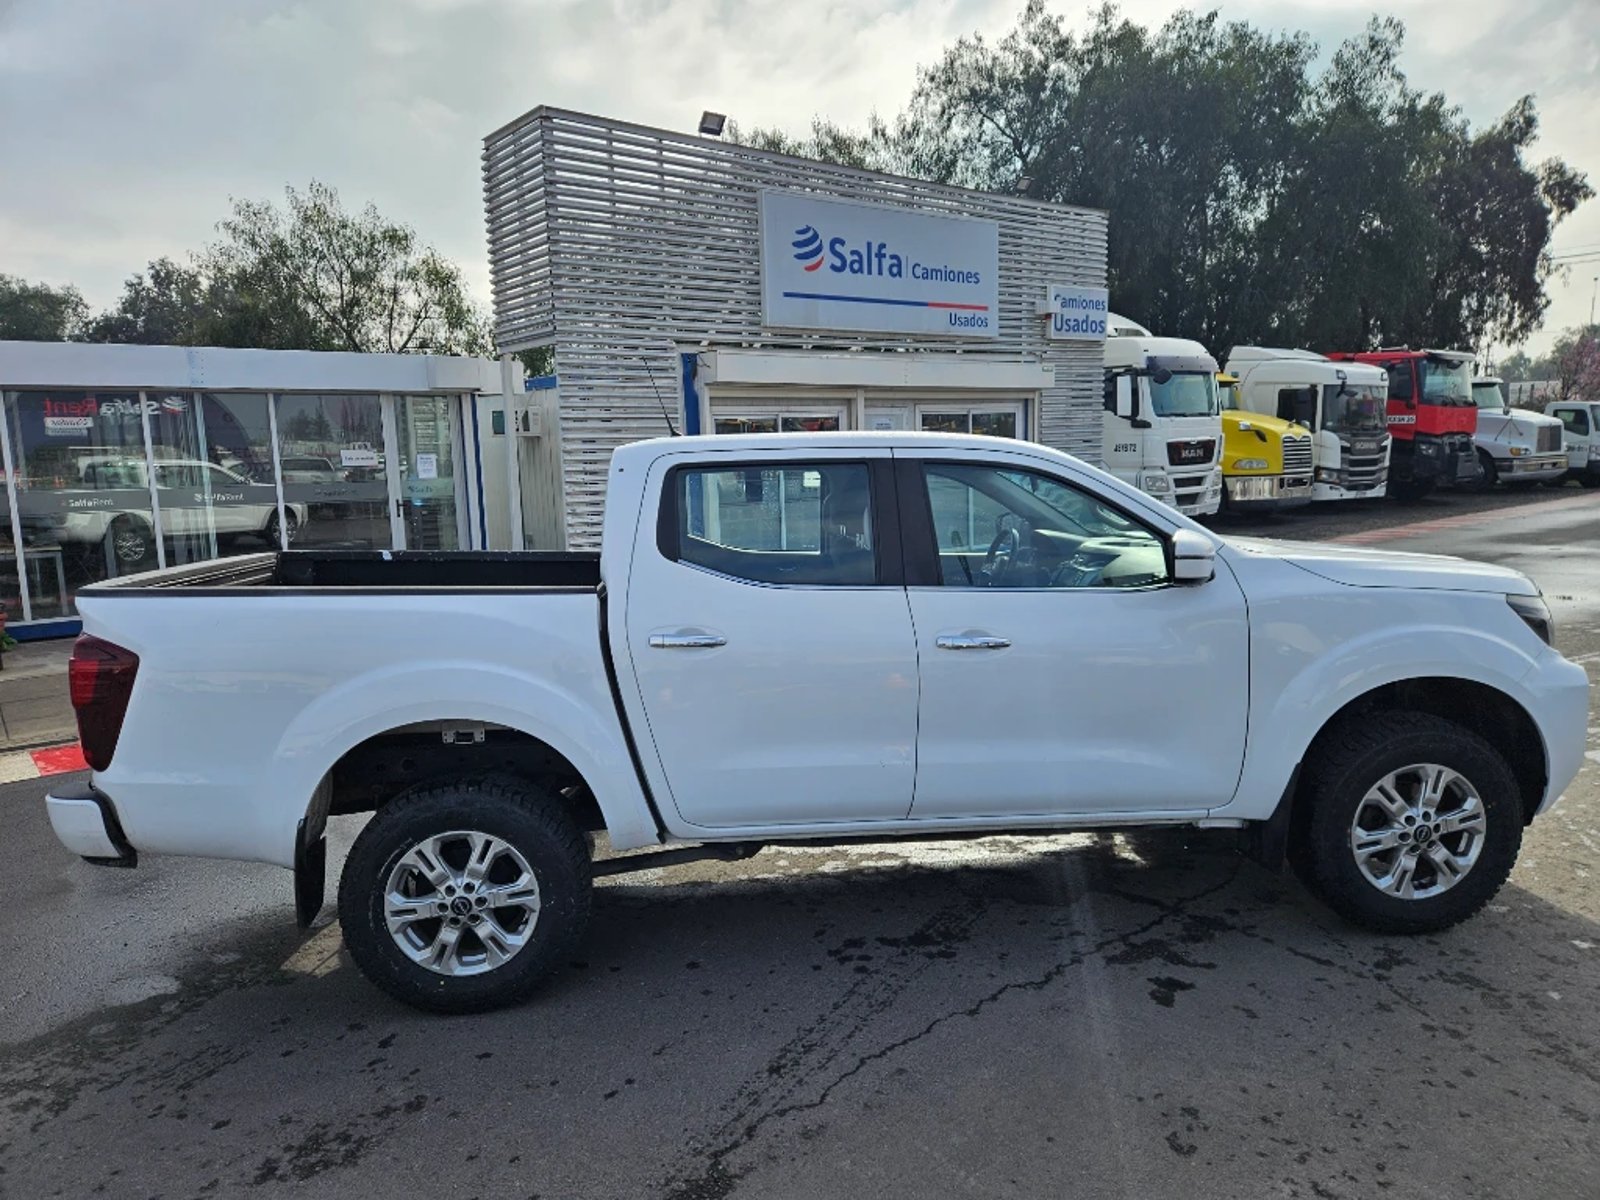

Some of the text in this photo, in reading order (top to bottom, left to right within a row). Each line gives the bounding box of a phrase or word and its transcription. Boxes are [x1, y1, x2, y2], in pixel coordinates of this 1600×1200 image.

[829, 237, 981, 285] Salfa Camiones
[949, 312, 989, 328] Usados
[1053, 313, 1106, 334] Usados
[1181, 446, 1204, 458] MAN
